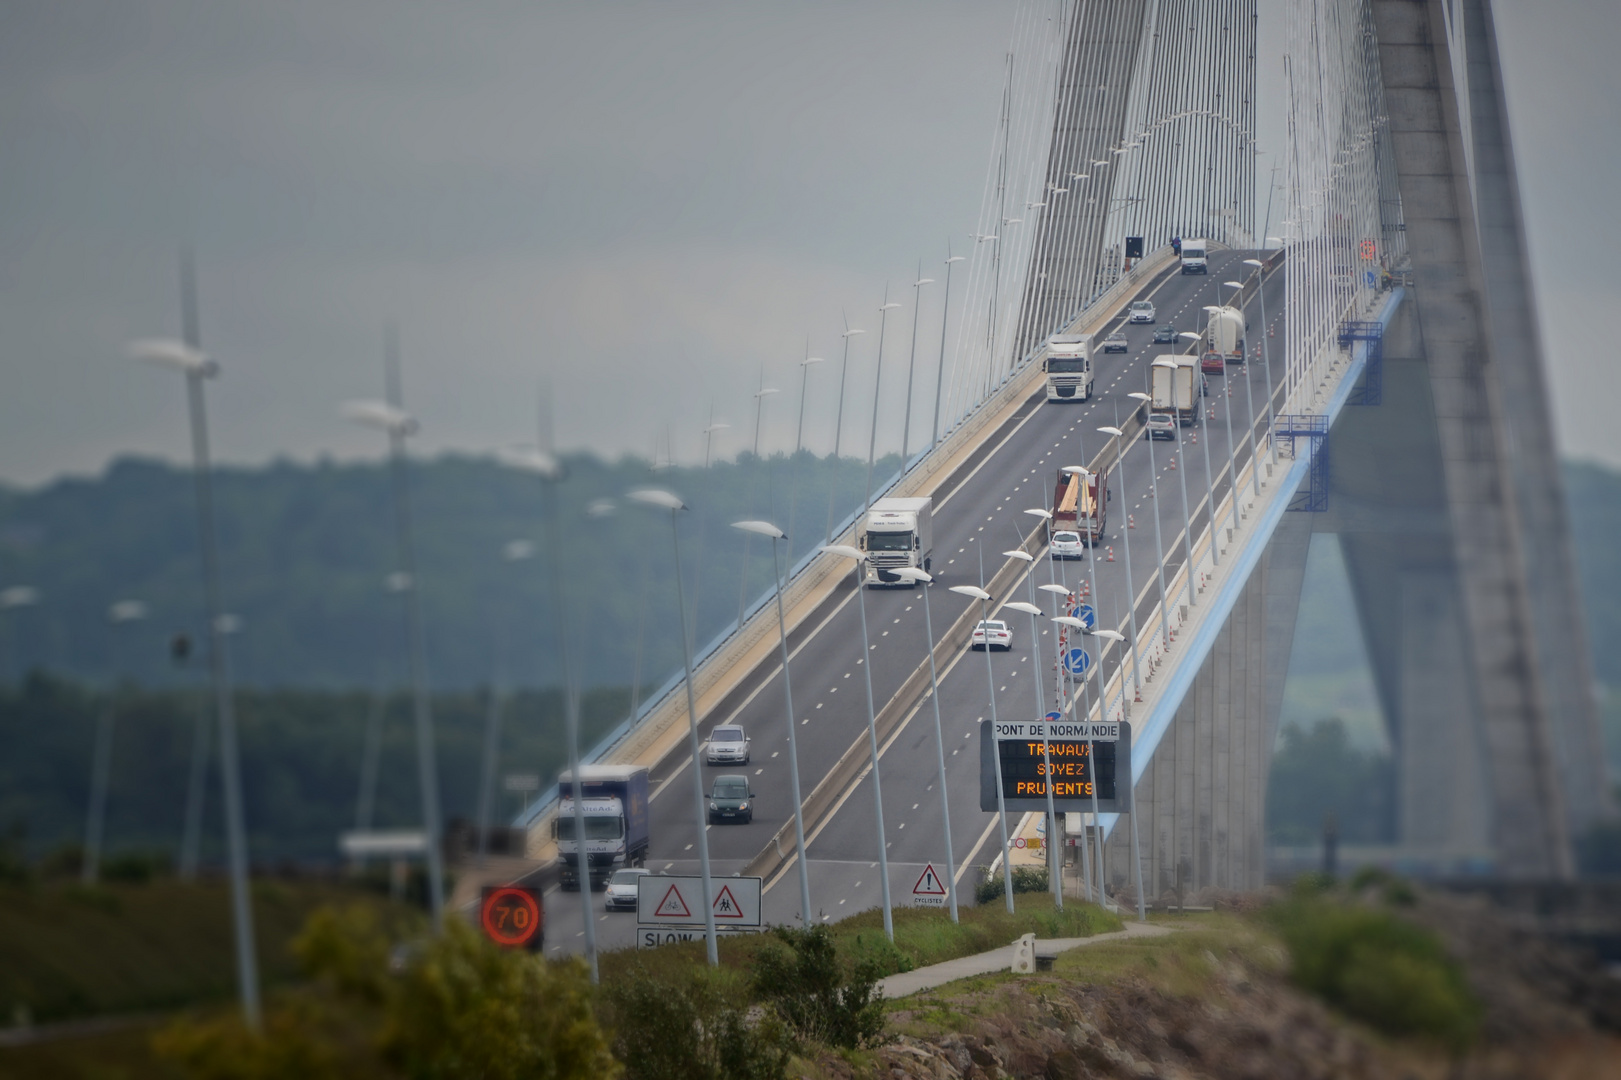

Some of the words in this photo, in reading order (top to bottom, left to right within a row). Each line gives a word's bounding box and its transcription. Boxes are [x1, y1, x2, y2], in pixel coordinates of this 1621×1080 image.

[1029, 725, 1044, 736] DE
[1036, 763, 1084, 776] SOYEZ
[496, 906, 529, 928] 70
